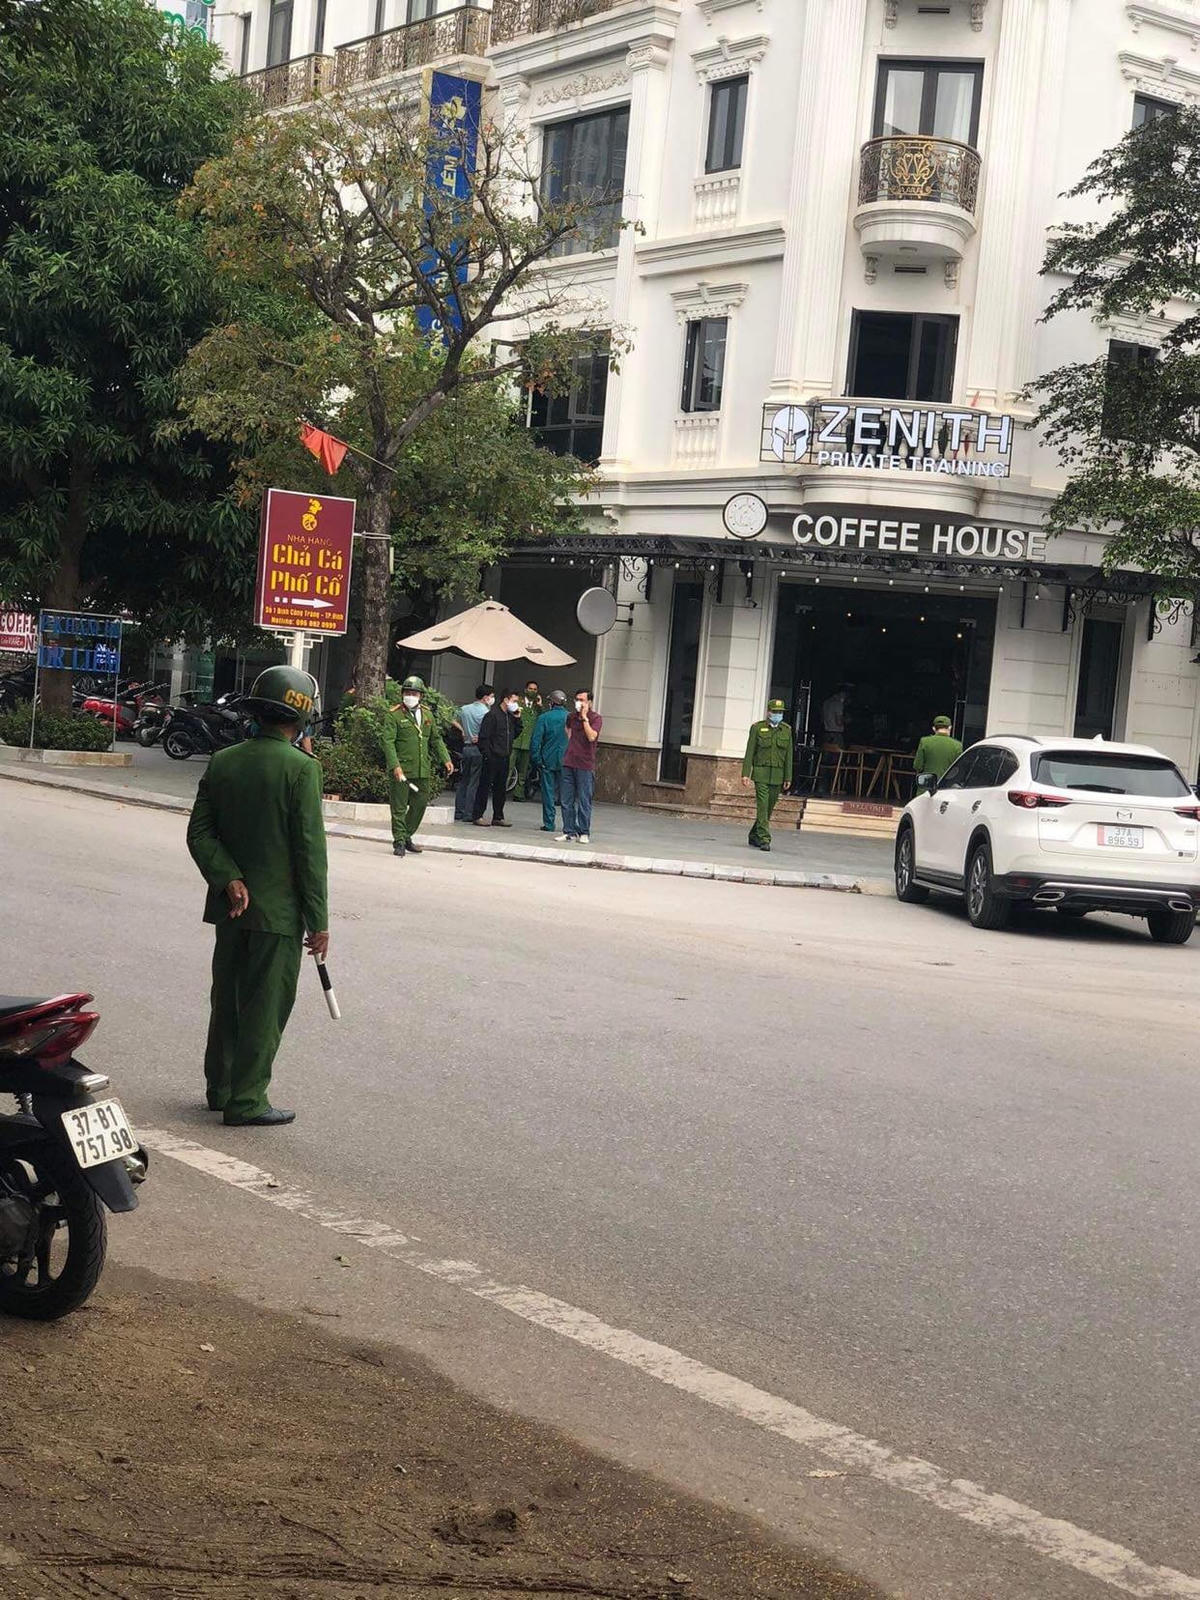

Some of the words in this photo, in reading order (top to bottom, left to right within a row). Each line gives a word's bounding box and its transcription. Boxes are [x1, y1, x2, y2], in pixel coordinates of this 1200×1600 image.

[818, 405, 1012, 454] ZENITH
[818, 451, 902, 471] PRIVATE
[909, 456, 1006, 477] TRAINING
[792, 514, 921, 553] COFFEE
[932, 524, 1047, 562] HOUSE
[272, 543, 311, 567] Chả
[318, 549, 343, 570] Cá
[271, 570, 313, 593] Phố
[315, 574, 344, 596] Cổ
[1115, 827, 1132, 837] 37A
[71, 1105, 118, 1136] 37-B1
[76, 1128, 133, 1163] 757.98
